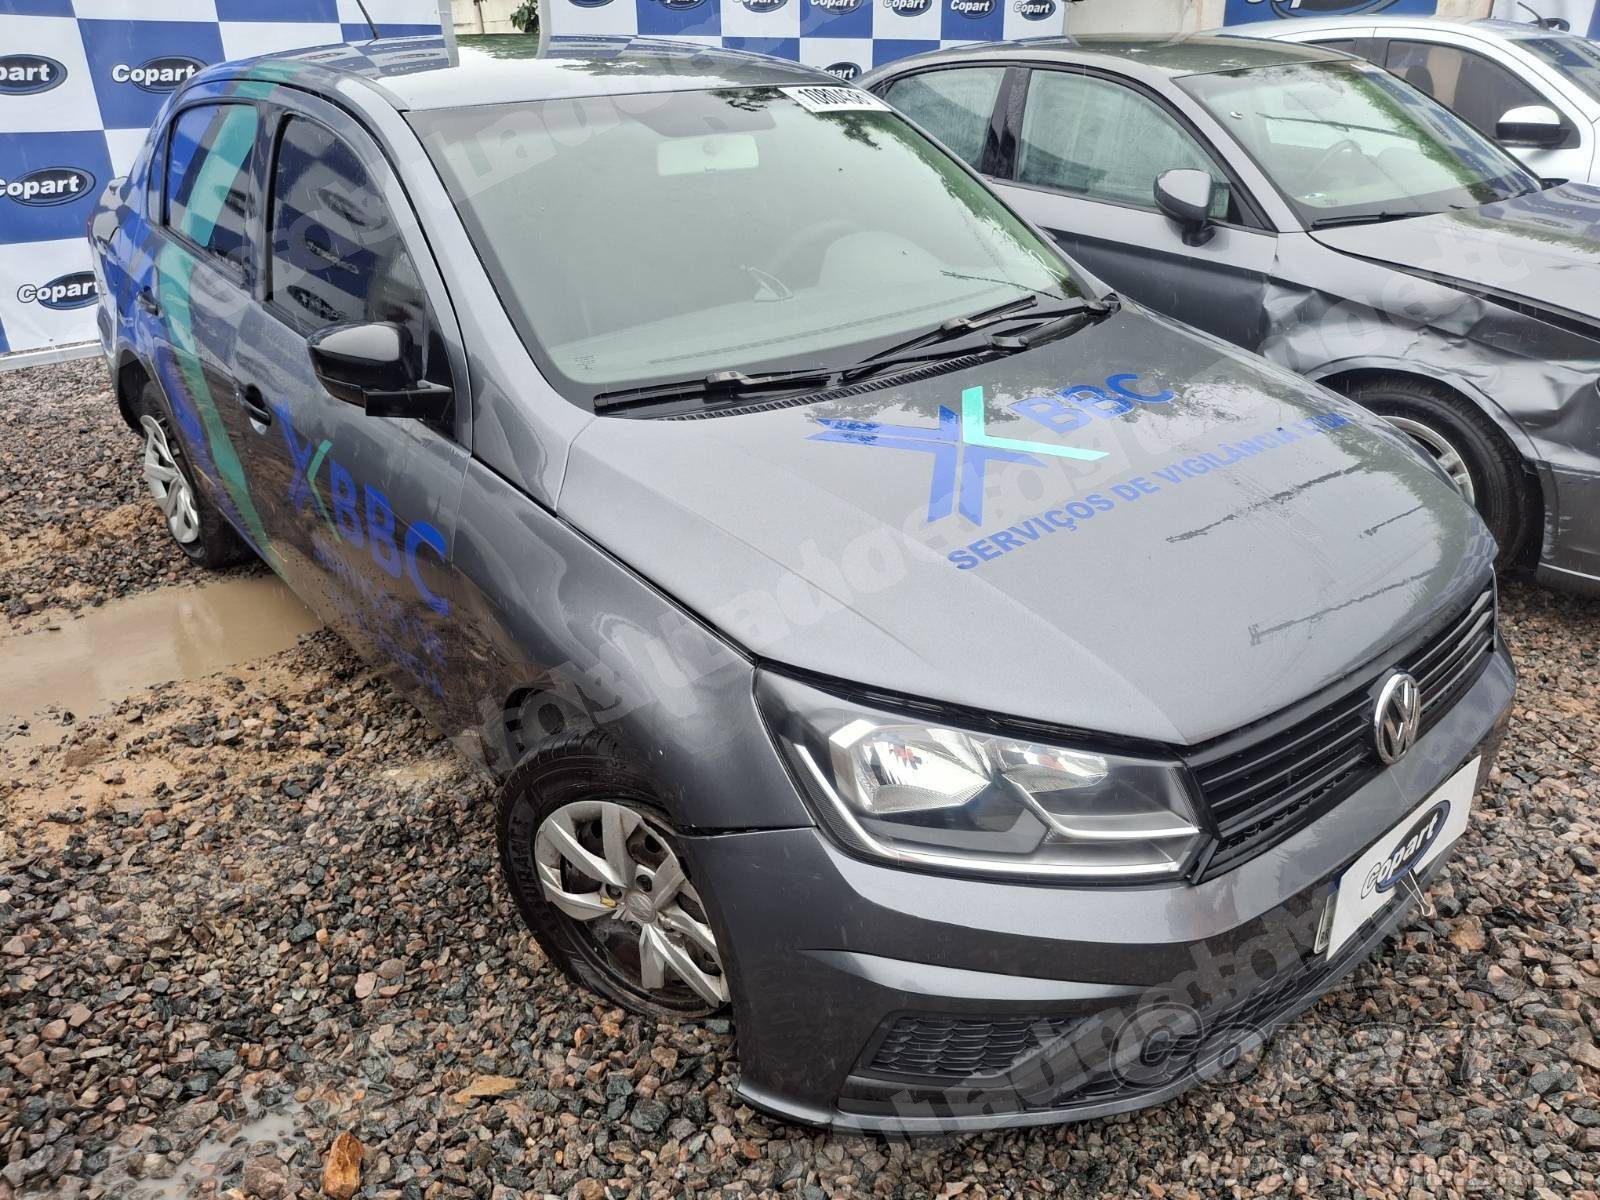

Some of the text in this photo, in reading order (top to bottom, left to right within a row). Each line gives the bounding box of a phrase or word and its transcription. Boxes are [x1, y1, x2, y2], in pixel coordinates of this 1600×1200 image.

[882, 0, 925, 10] Copart
[950, 0, 991, 13] Copart
[1013, 1, 1051, 15] Copart
[111, 63, 196, 86] Copart
[1007, 373, 1174, 434] BBC
[947, 493, 1115, 571] SERVIÇOS
[1108, 472, 1161, 505] DE
[1151, 427, 1300, 487] VIGILÂNCIA
[329, 459, 451, 618] BBC
[1360, 812, 1439, 899] Copart
